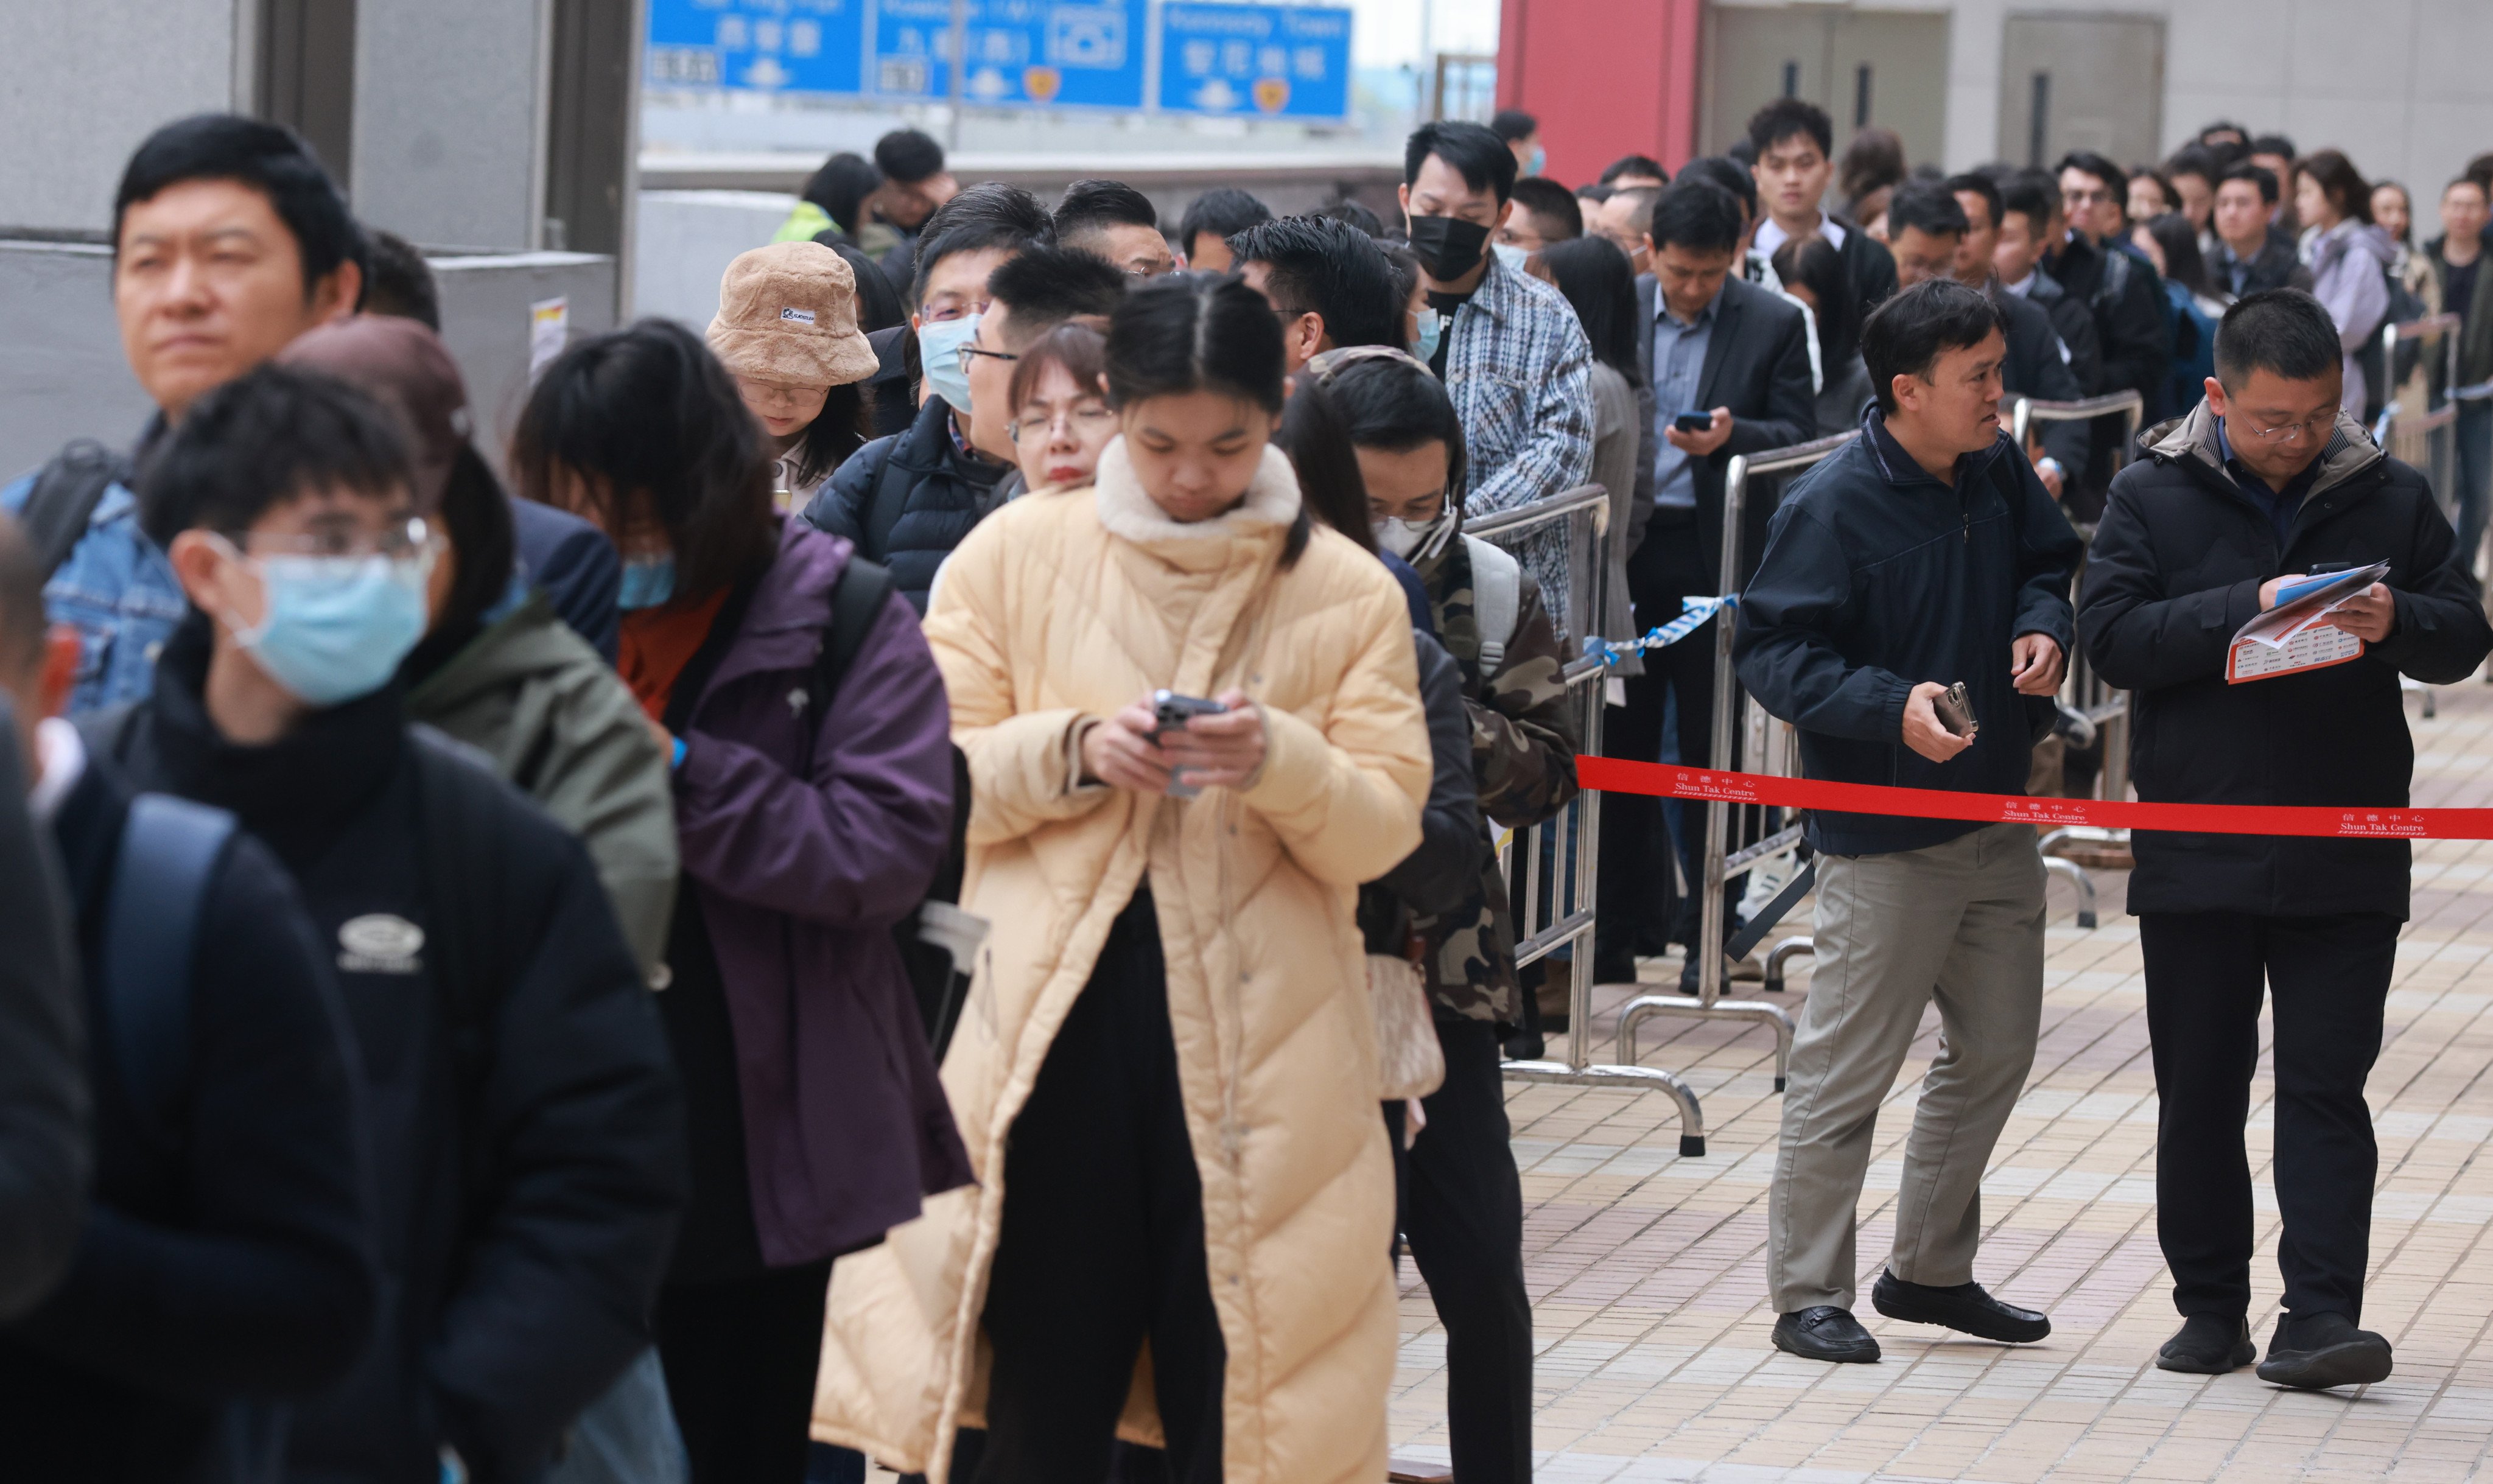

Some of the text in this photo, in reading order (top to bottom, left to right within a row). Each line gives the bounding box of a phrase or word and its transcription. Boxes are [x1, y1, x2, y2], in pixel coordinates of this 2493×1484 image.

[1677, 773, 1755, 787] 信德中心
[1675, 783, 1700, 791] Shun
[1723, 788, 1755, 796] Centre
[2005, 801, 2086, 813] 信德中心
